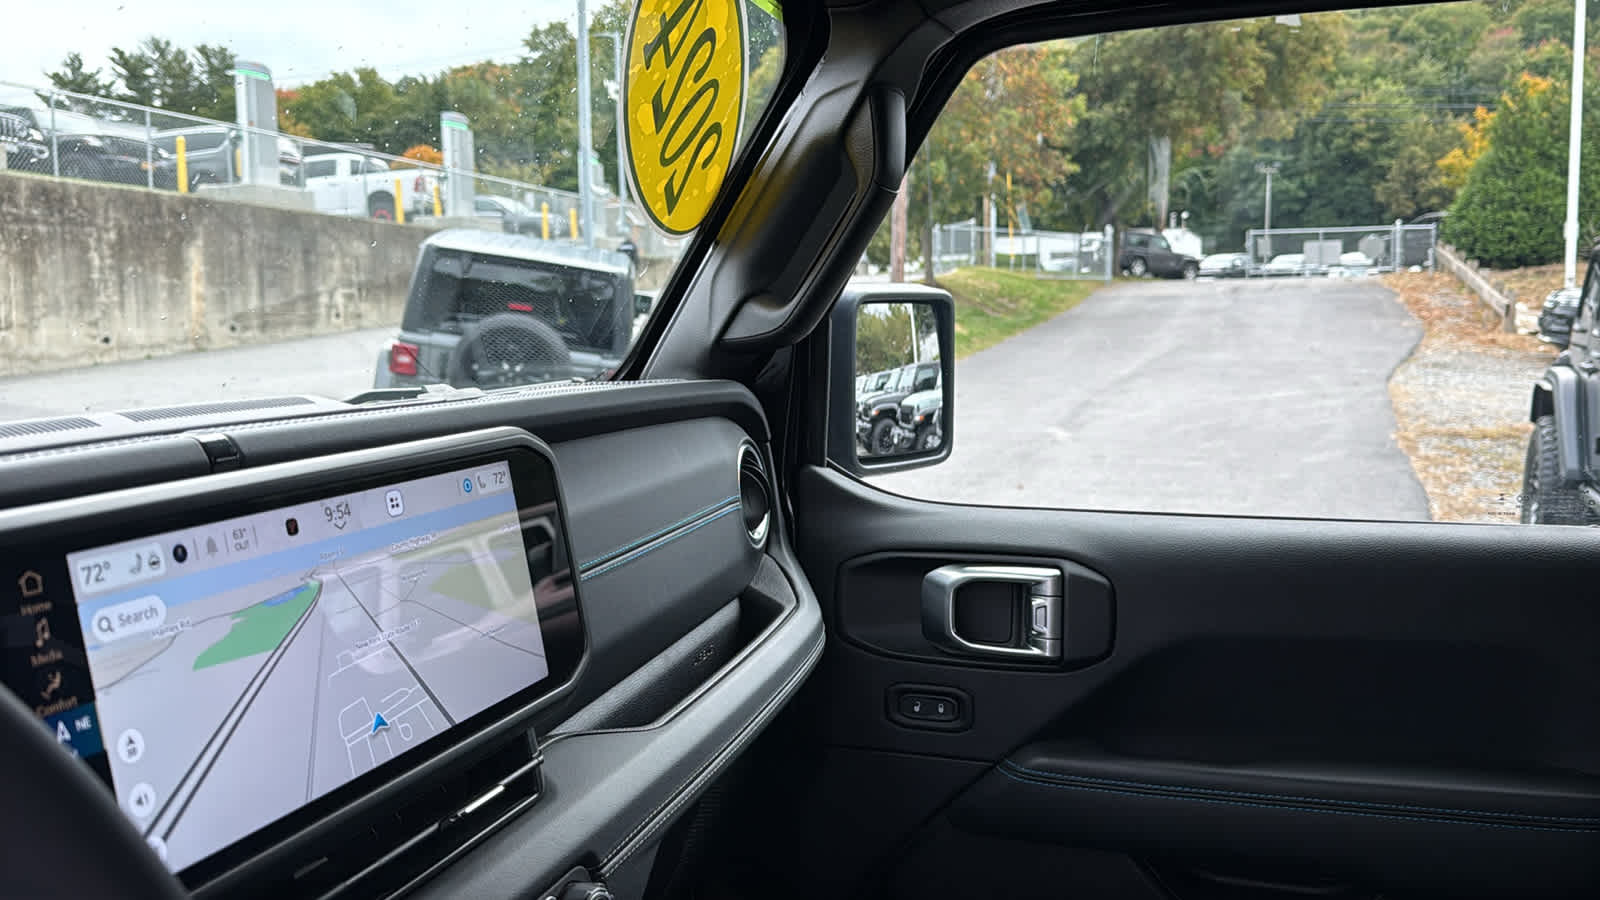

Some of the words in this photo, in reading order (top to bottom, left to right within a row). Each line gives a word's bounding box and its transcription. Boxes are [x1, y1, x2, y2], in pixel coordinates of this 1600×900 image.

[324, 503, 352, 523] 9:54
[232, 527, 248, 540] 63°
[234, 540, 250, 553] OUT
[80, 560, 111, 585] 72°
[20, 600, 52, 616] Home
[117, 605, 160, 629] Search
[30, 650, 63, 667] Media
[35, 696, 78, 717] Comfort
[74, 716, 92, 731] NE
